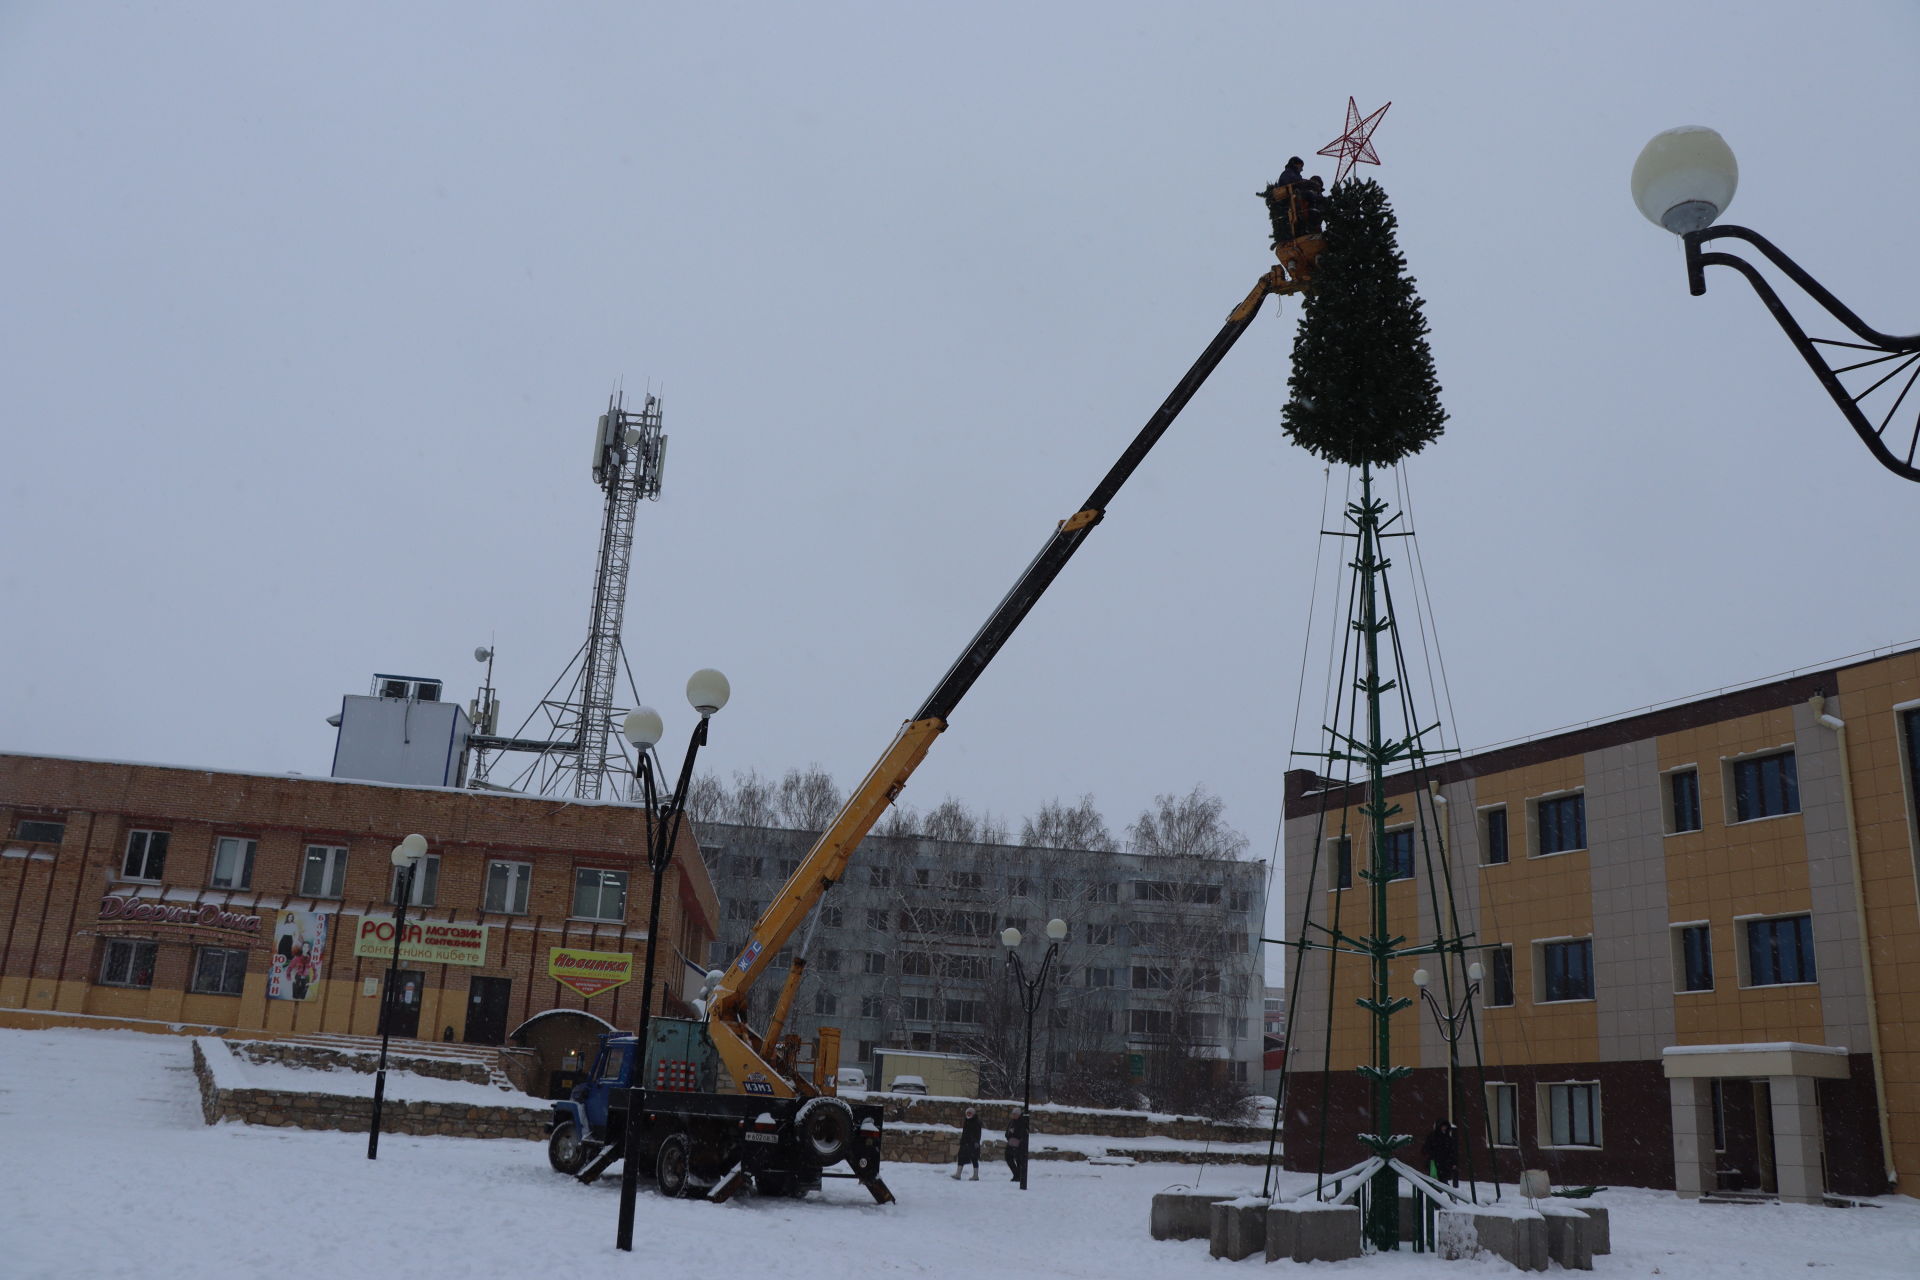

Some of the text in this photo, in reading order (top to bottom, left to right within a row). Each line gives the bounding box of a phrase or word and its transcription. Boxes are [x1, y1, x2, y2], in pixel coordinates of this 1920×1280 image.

[436, 949, 480, 962] кибете
[554, 953, 630, 973] Новинка
[271, 955, 285, 995] ЮБКИ
